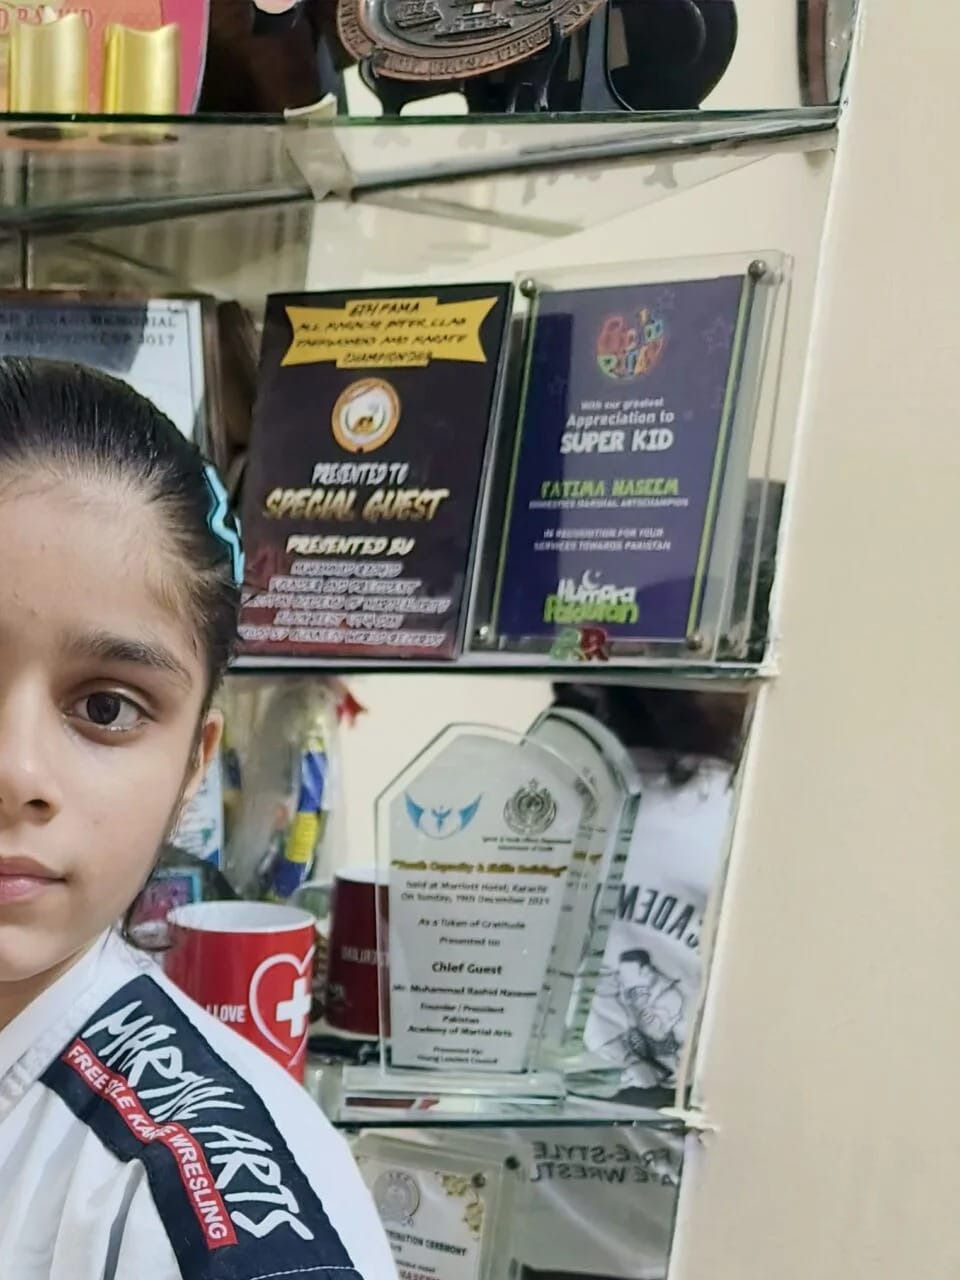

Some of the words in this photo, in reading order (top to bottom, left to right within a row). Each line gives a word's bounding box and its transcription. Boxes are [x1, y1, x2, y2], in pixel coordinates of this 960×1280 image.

[566, 409, 656, 429] Appreciation
[660, 410, 674, 424] to
[560, 430, 624, 454] SUPER
[632, 428, 674, 450] KID
[311, 462, 387, 485] PRESENTED
[389, 463, 409, 485] TO
[542, 480, 605, 499] FATIMA
[611, 478, 679, 496] NASEEM
[263, 487, 358, 521] SPECIAL
[362, 488, 450, 523] GUEST
[286, 534, 387, 555] PRESENTED
[388, 536, 416, 555] BY
[441, 881, 480, 892] Marriott
[418, 918, 430, 927] As
[441, 919, 468, 928] Token
[470, 920, 480, 928] of
[481, 919, 526, 930] Gratitude
[432, 961, 465, 974] Chief
[467, 963, 503, 975] Guest
[410, 984, 465, 995] Muhammad
[442, 1015, 480, 1025] Pakistan
[408, 1025, 447, 1035] Academy
[449, 1026, 459, 1035] of
[461, 1027, 492, 1037] Martial
[493, 1029, 513, 1038] Arts
[169, 1131, 229, 1241] WRESLING
[189, 1124, 315, 1241] ARTS
